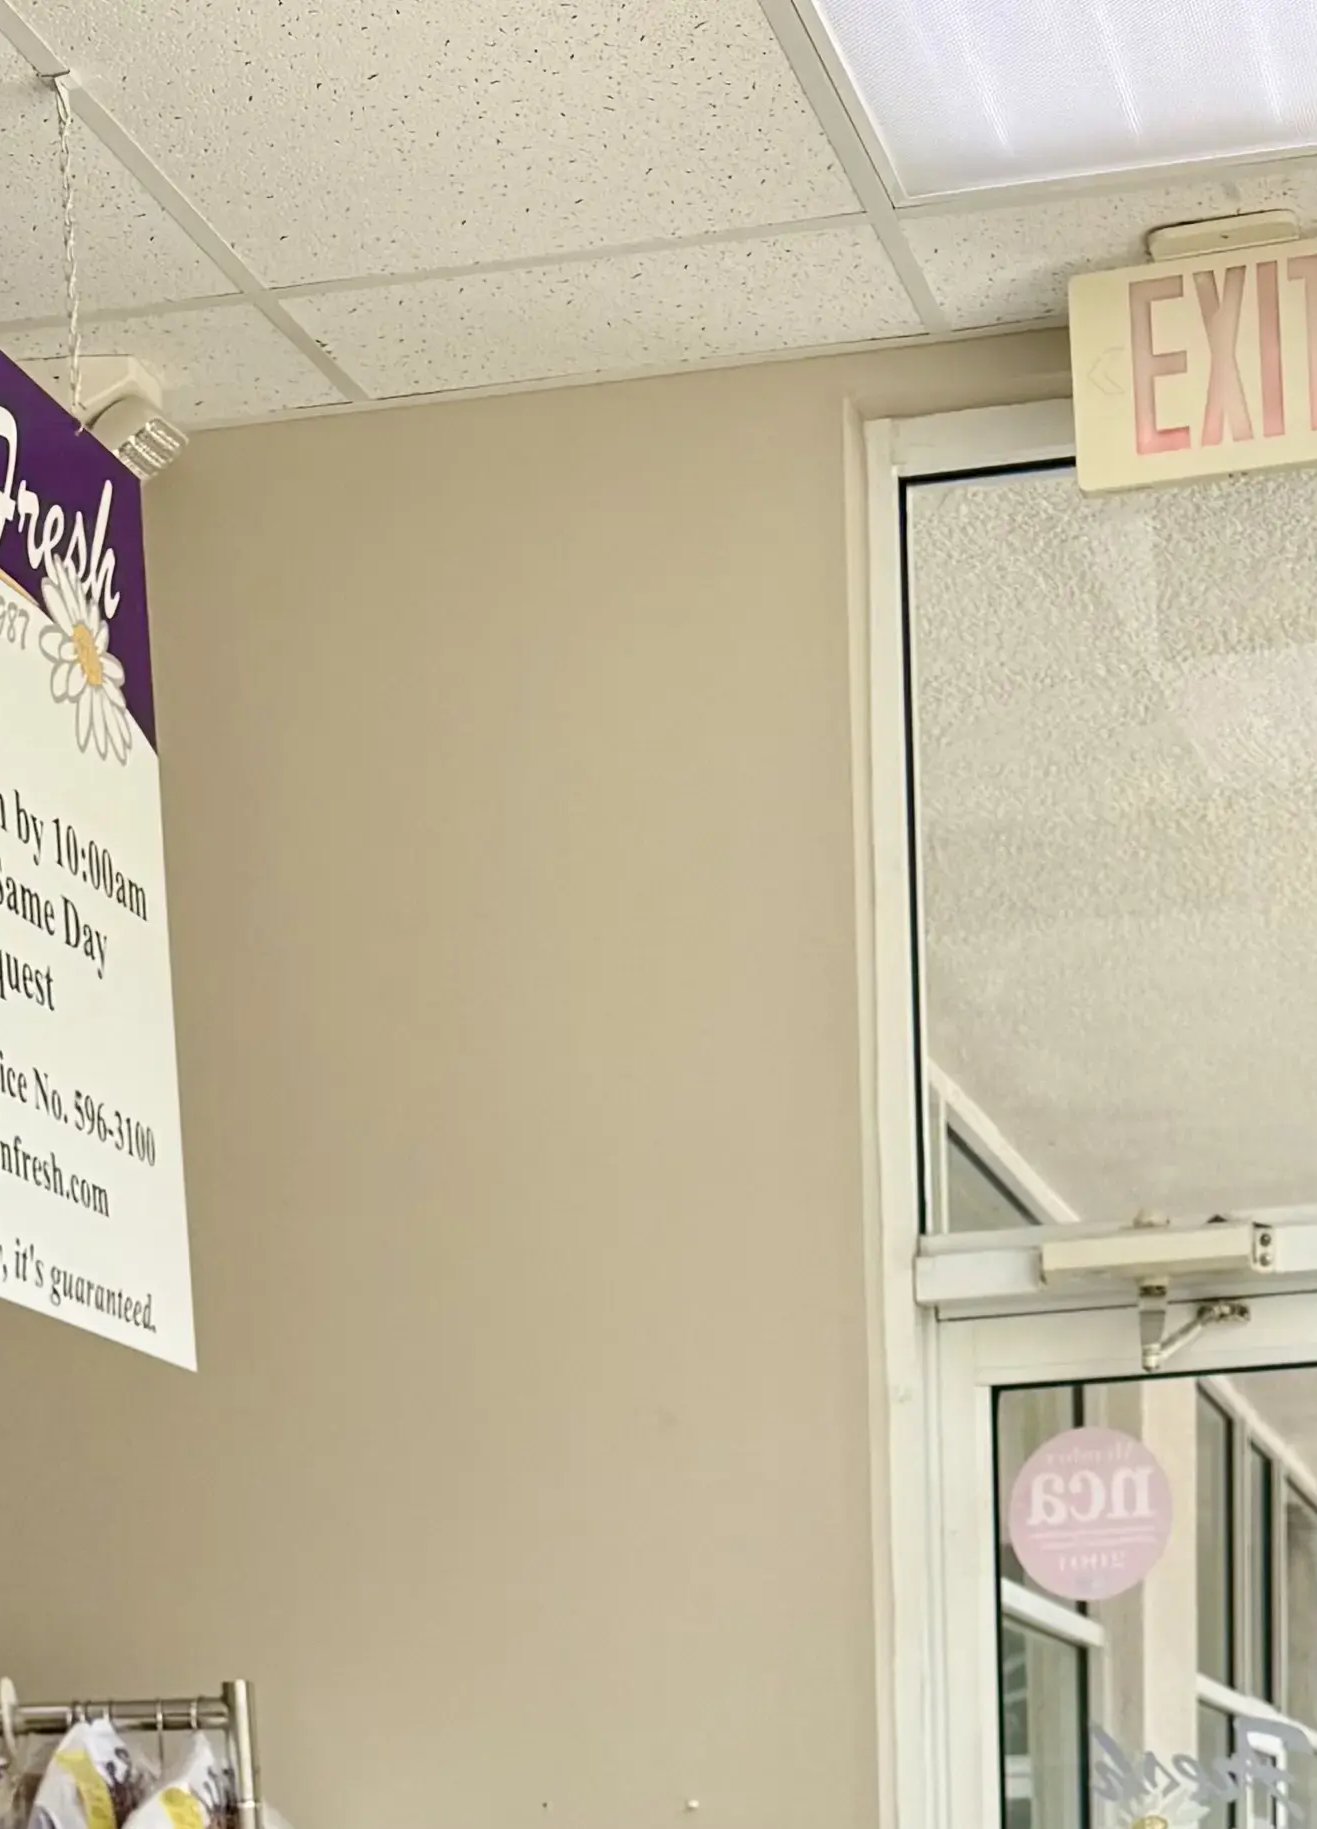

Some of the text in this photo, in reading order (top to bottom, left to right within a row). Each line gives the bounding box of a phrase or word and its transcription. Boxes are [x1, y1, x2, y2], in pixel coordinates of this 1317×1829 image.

[14, 790, 45, 867] by
[51, 817, 149, 922] 10:00am
[62, 895, 109, 979] Day
[33, 1068, 70, 1126] No.
[73, 1089, 157, 1168] 596-3100
[14, 1237, 45, 1289] it's
[50, 1263, 158, 1334] guaranteed.
